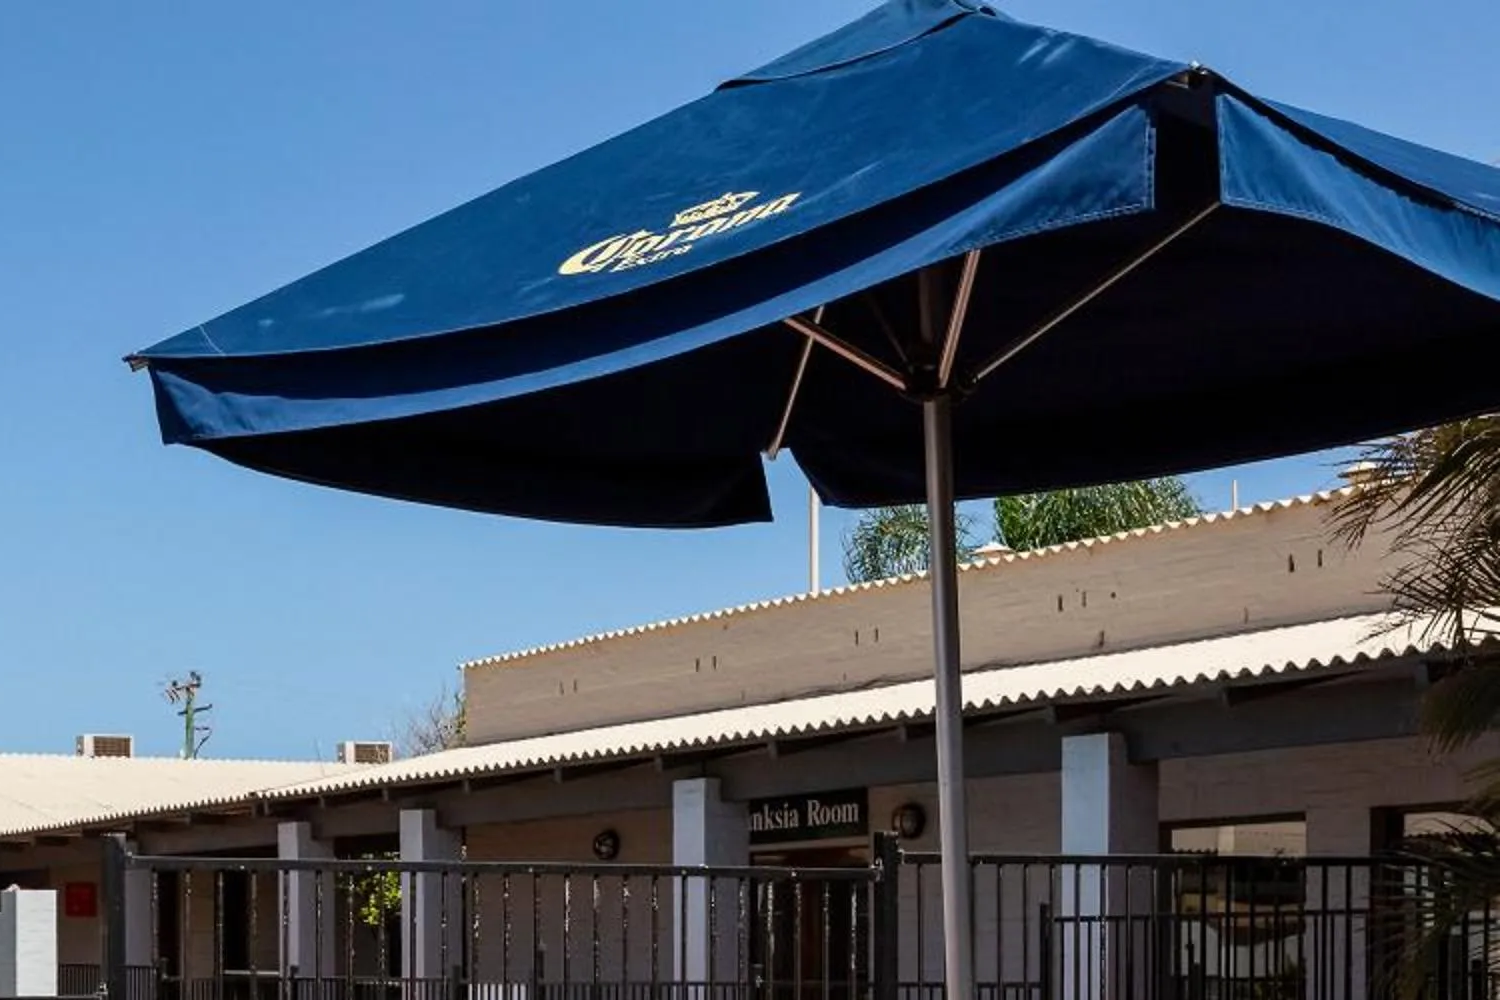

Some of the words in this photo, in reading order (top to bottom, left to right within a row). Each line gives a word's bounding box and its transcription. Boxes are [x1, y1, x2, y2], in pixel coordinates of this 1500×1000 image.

[558, 191, 802, 275] Corona
[749, 802, 799, 832] nksia
[806, 799, 860, 827] Room
